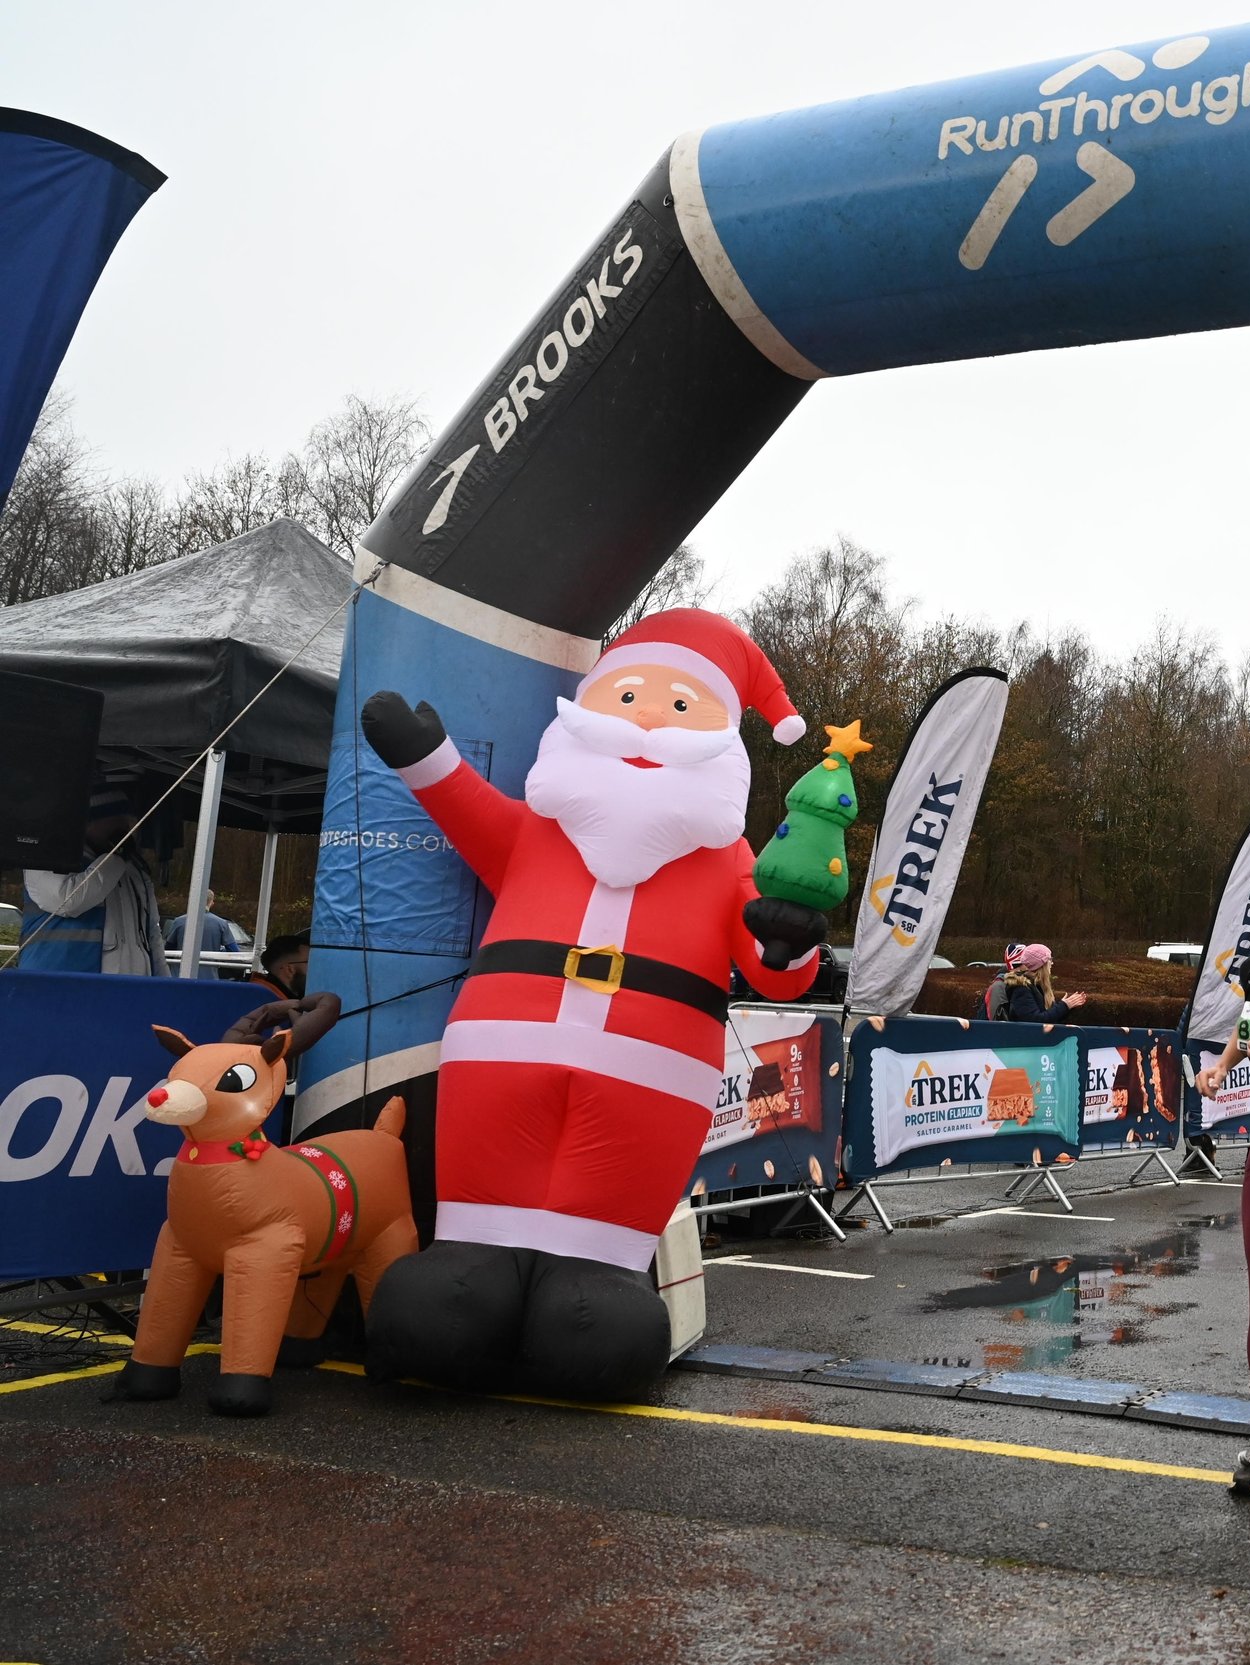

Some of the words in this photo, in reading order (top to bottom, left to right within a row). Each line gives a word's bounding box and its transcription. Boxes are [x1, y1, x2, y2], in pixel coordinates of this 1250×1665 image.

[483, 227, 643, 454] BROOKS
[883, 772, 963, 926] TREK
[1041, 1054, 1056, 1071] 9G
[911, 1073, 982, 1107] TREK
[1216, 1092, 1238, 1104] PROTEIN
[715, 1108, 741, 1127] FLAPJACK
[905, 1110, 946, 1127] PROTEIN
[949, 1106, 981, 1120] FLAPJACK
[717, 1130, 727, 1139] OAT
[917, 1127, 941, 1137] SALTED
[943, 1123, 973, 1132] CARAMEL
